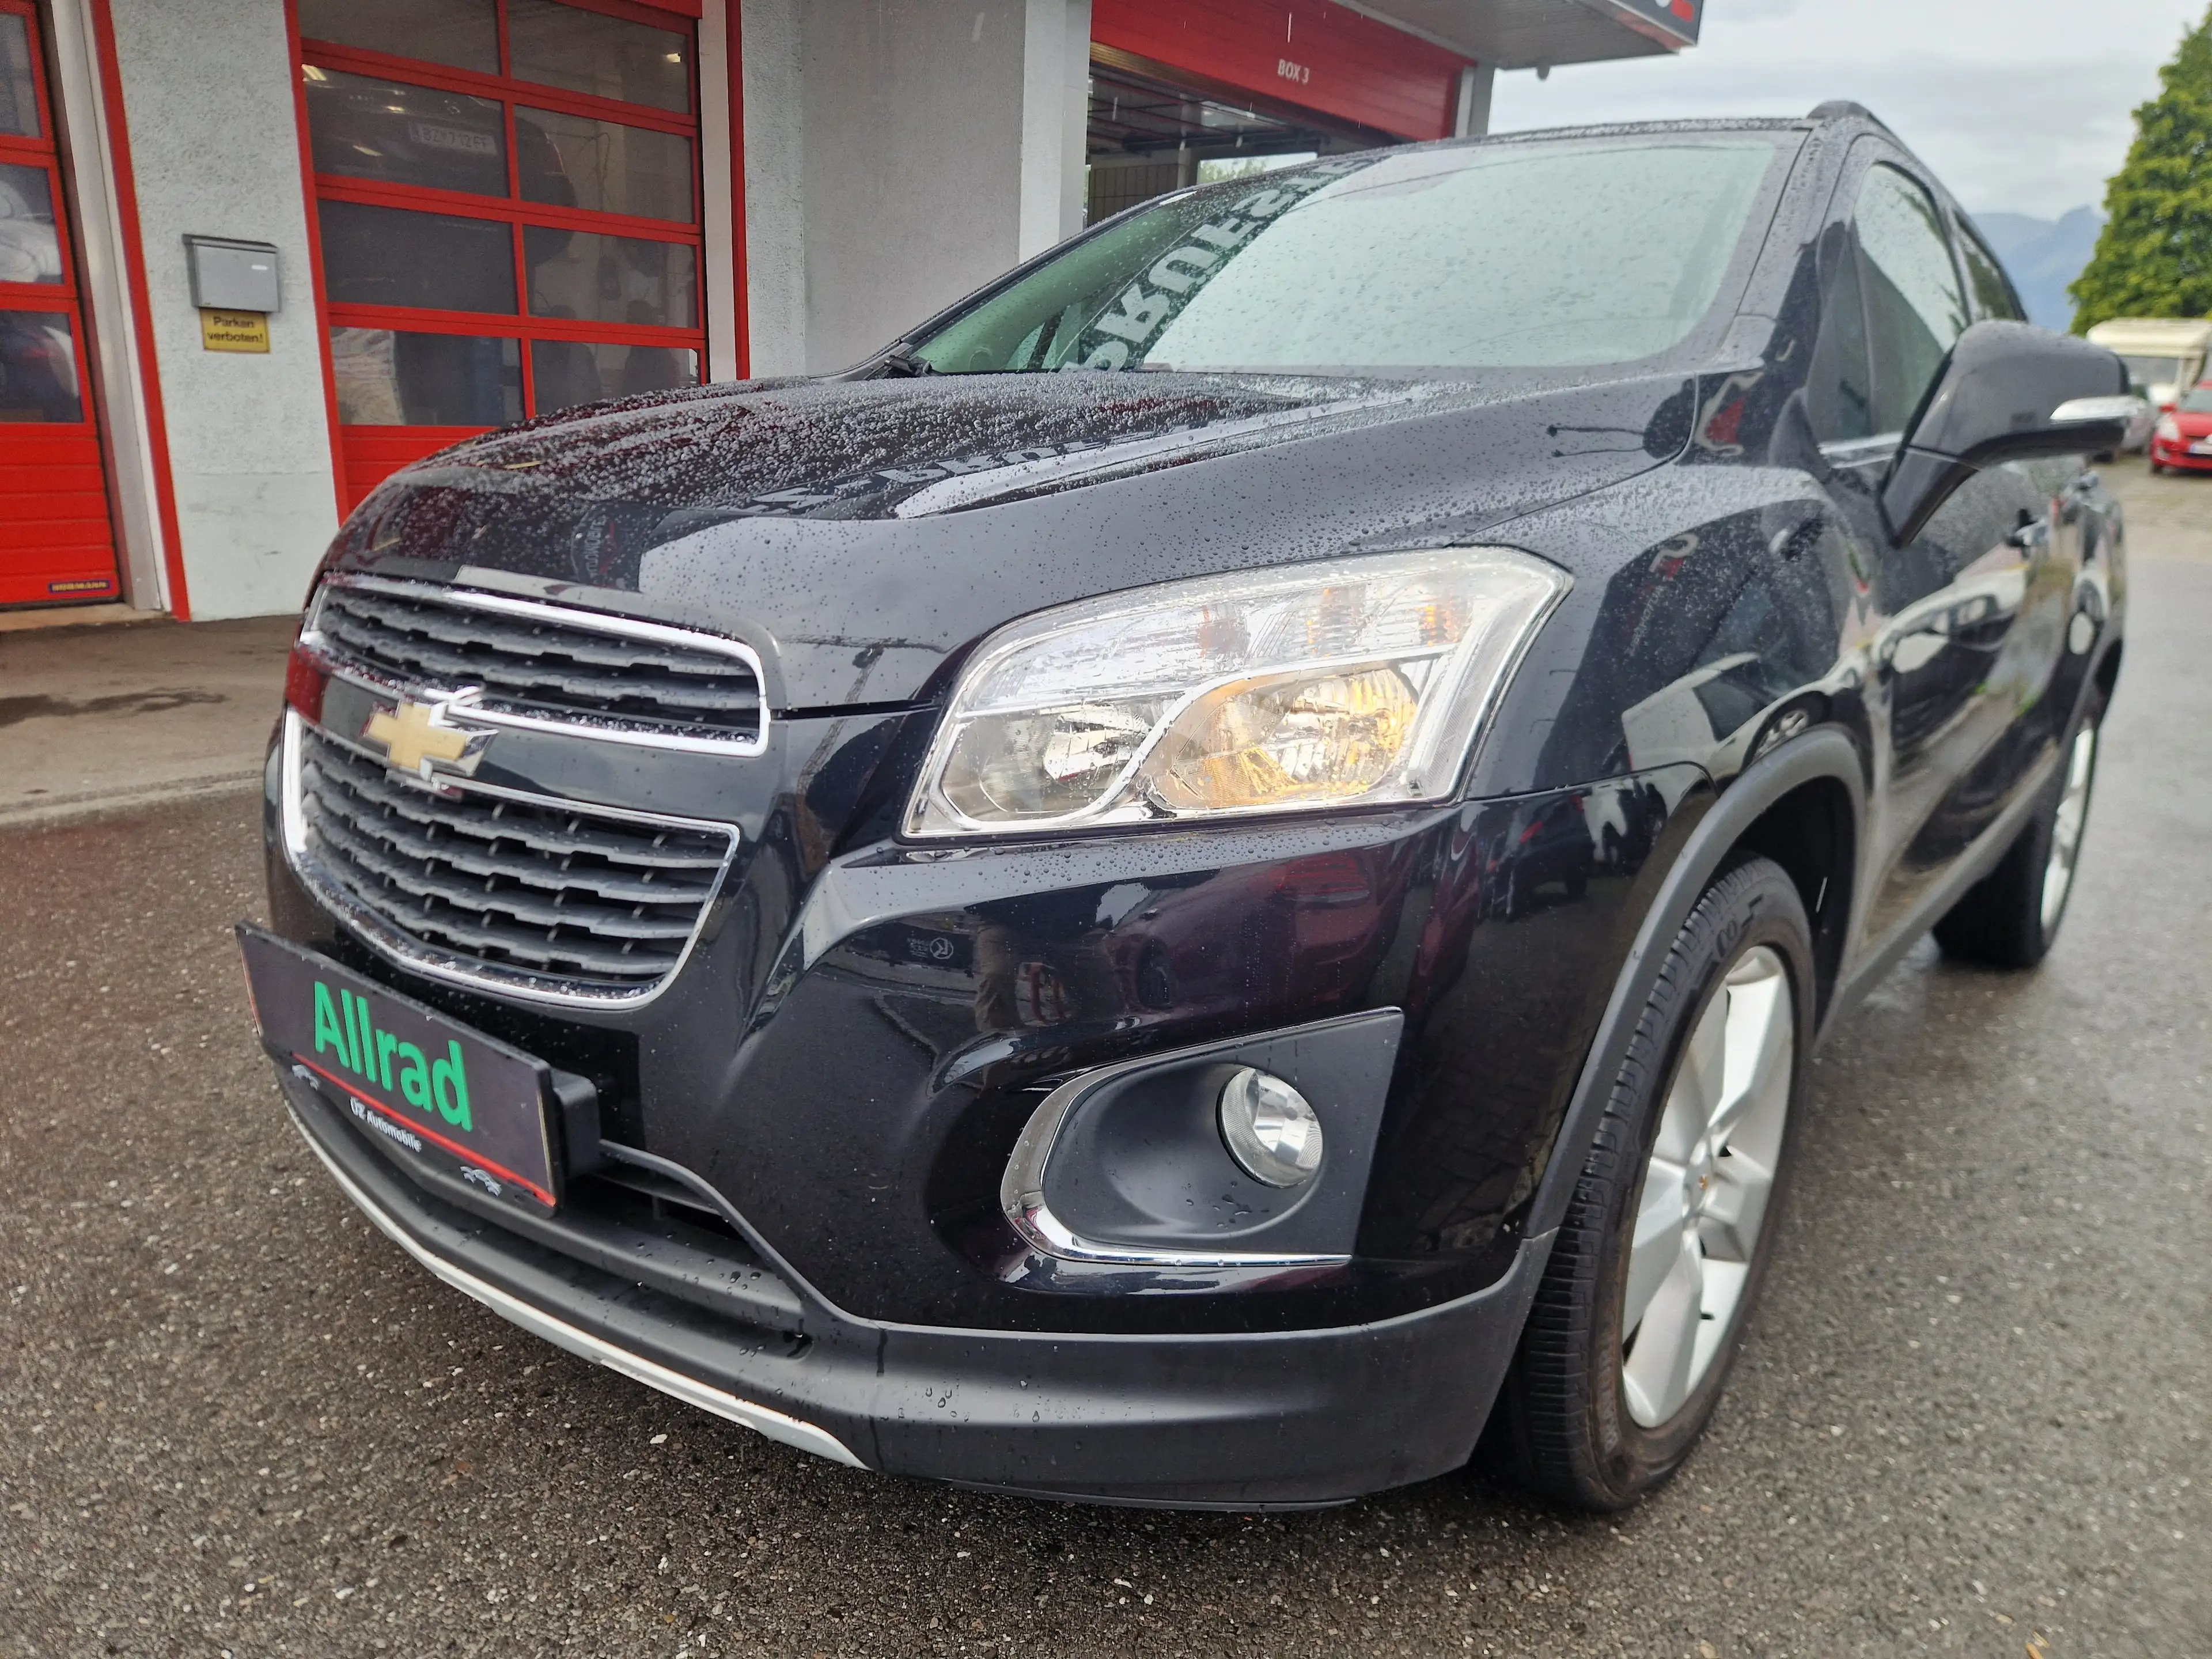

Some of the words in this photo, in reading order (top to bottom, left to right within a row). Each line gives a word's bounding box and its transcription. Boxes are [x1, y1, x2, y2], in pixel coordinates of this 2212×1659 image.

[1278, 58, 1301, 82] BOX
[1302, 67, 1310, 85] 3
[213, 316, 254, 328] Parken
[207, 331, 263, 343] verboten!
[314, 980, 473, 1132] Allrad
[367, 1109, 422, 1153] Automobile
